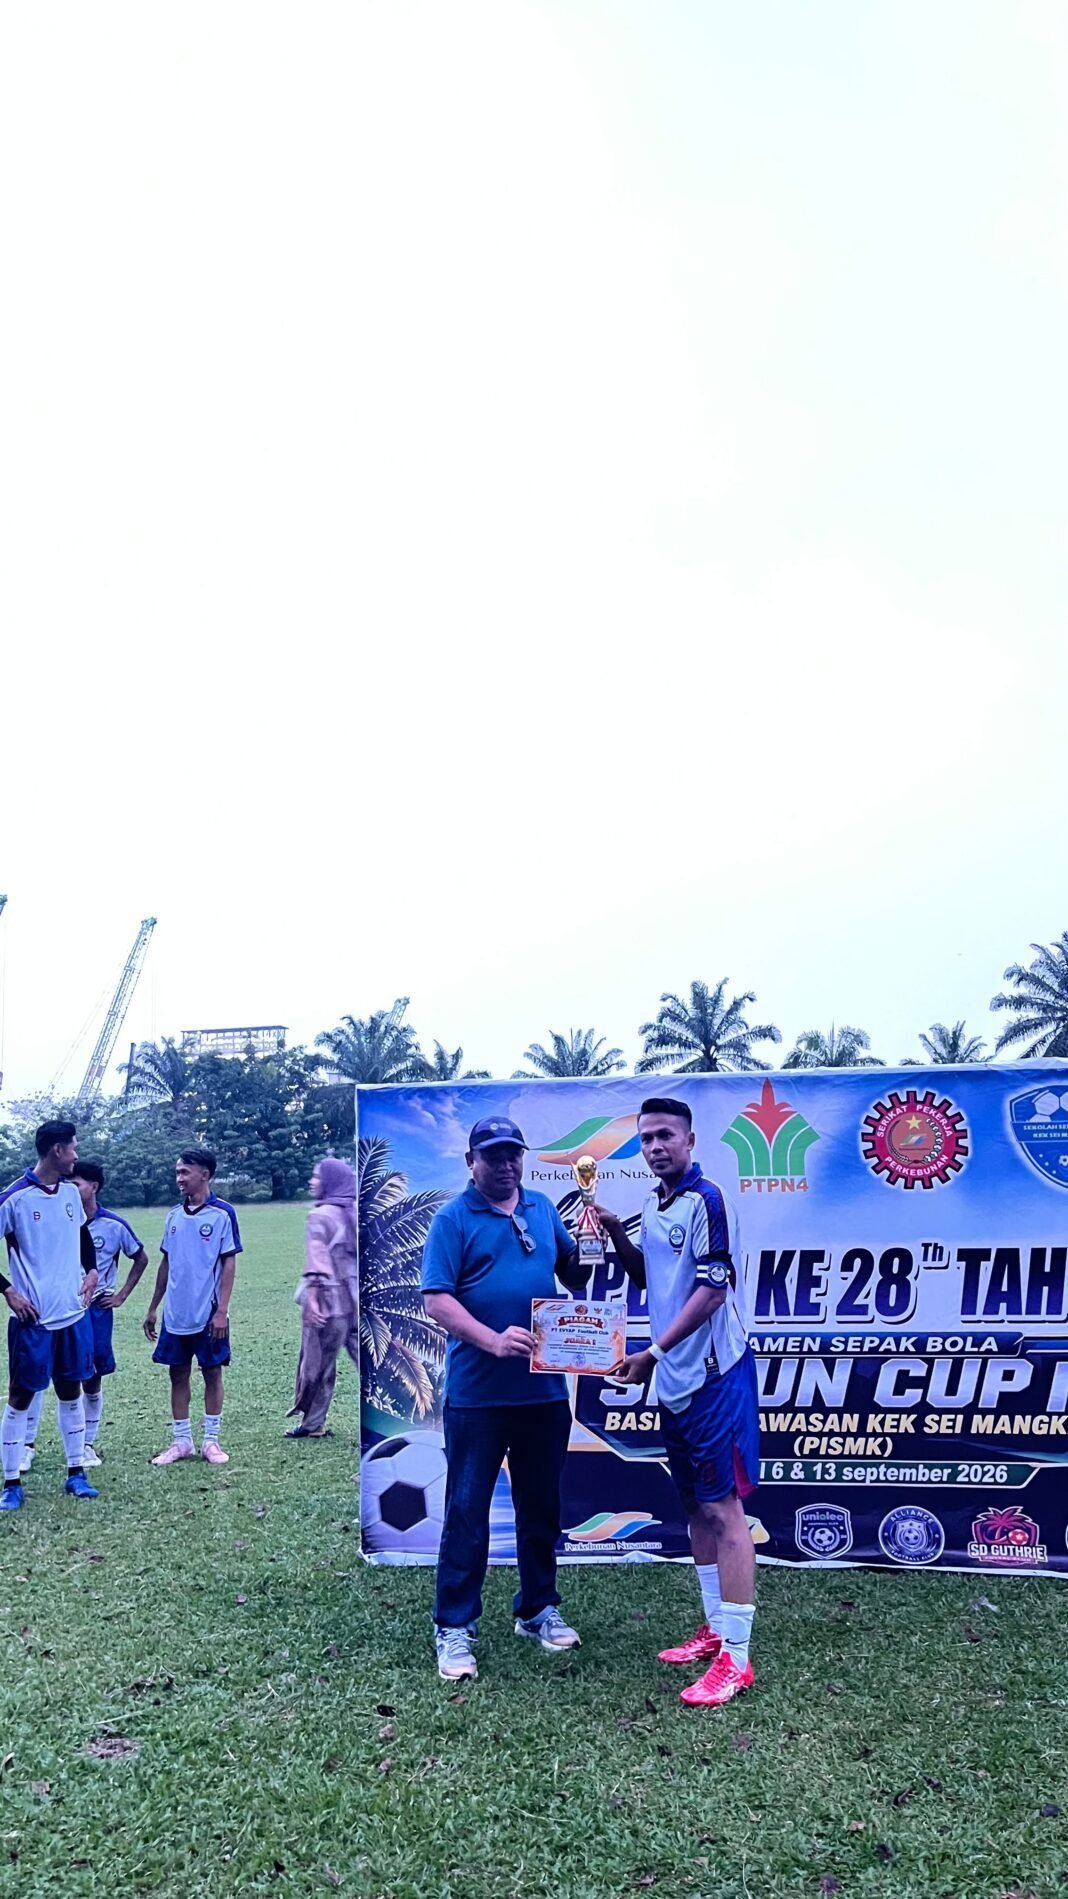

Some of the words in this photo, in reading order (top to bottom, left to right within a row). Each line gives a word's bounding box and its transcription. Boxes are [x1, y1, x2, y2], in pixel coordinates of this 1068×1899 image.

[877, 1105, 908, 1138] SERIKAT
[916, 1104, 953, 1137] PEKERJA
[884, 1154, 949, 1176] PERKEBUNAN
[739, 1178, 809, 1193] PTPN4
[754, 1249, 826, 1317] KE
[956, 1247, 1068, 1317] TAH
[563, 1316, 599, 1325] PIAGAM
[749, 1336, 821, 1352] AMEN
[829, 1336, 917, 1352] SEPAK
[926, 1337, 998, 1352] BOLA
[873, 1358, 1034, 1408] CUP
[866, 1413, 917, 1433] KEK
[923, 1414, 963, 1434] SEI
[970, 1414, 1068, 1435] MANGK
[793, 1435, 893, 1458] (PISMK)
[772, 1462, 784, 1480] 6
[790, 1462, 805, 1480] &
[812, 1463, 836, 1480] 13
[842, 1465, 951, 1484] september
[956, 1465, 1008, 1483] 2026
[890, 1509, 934, 1524] ALLIANCE
[564, 1542, 616, 1551] Perkebunan
[616, 1541, 662, 1550] Nusantara
[970, 1544, 988, 1557] SD
[991, 1544, 1044, 1560] GUTHRIE
